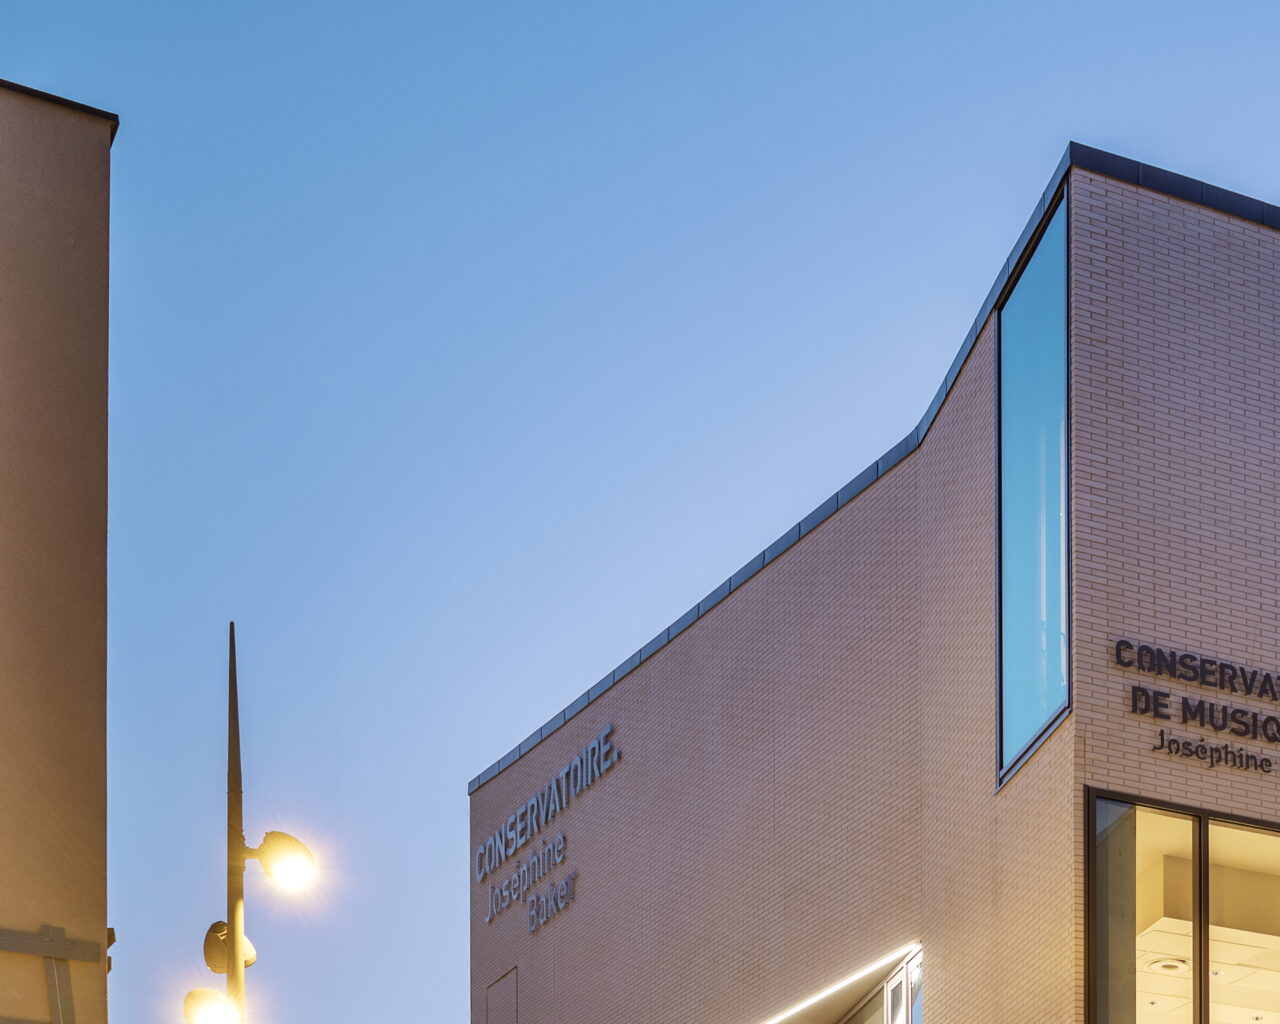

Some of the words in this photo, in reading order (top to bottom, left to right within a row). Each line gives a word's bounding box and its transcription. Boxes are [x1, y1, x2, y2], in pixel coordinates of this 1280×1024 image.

[1131, 685, 1171, 720] DE
[1151, 729, 1273, 774] Joséphine
[527, 871, 577, 933] Baker
